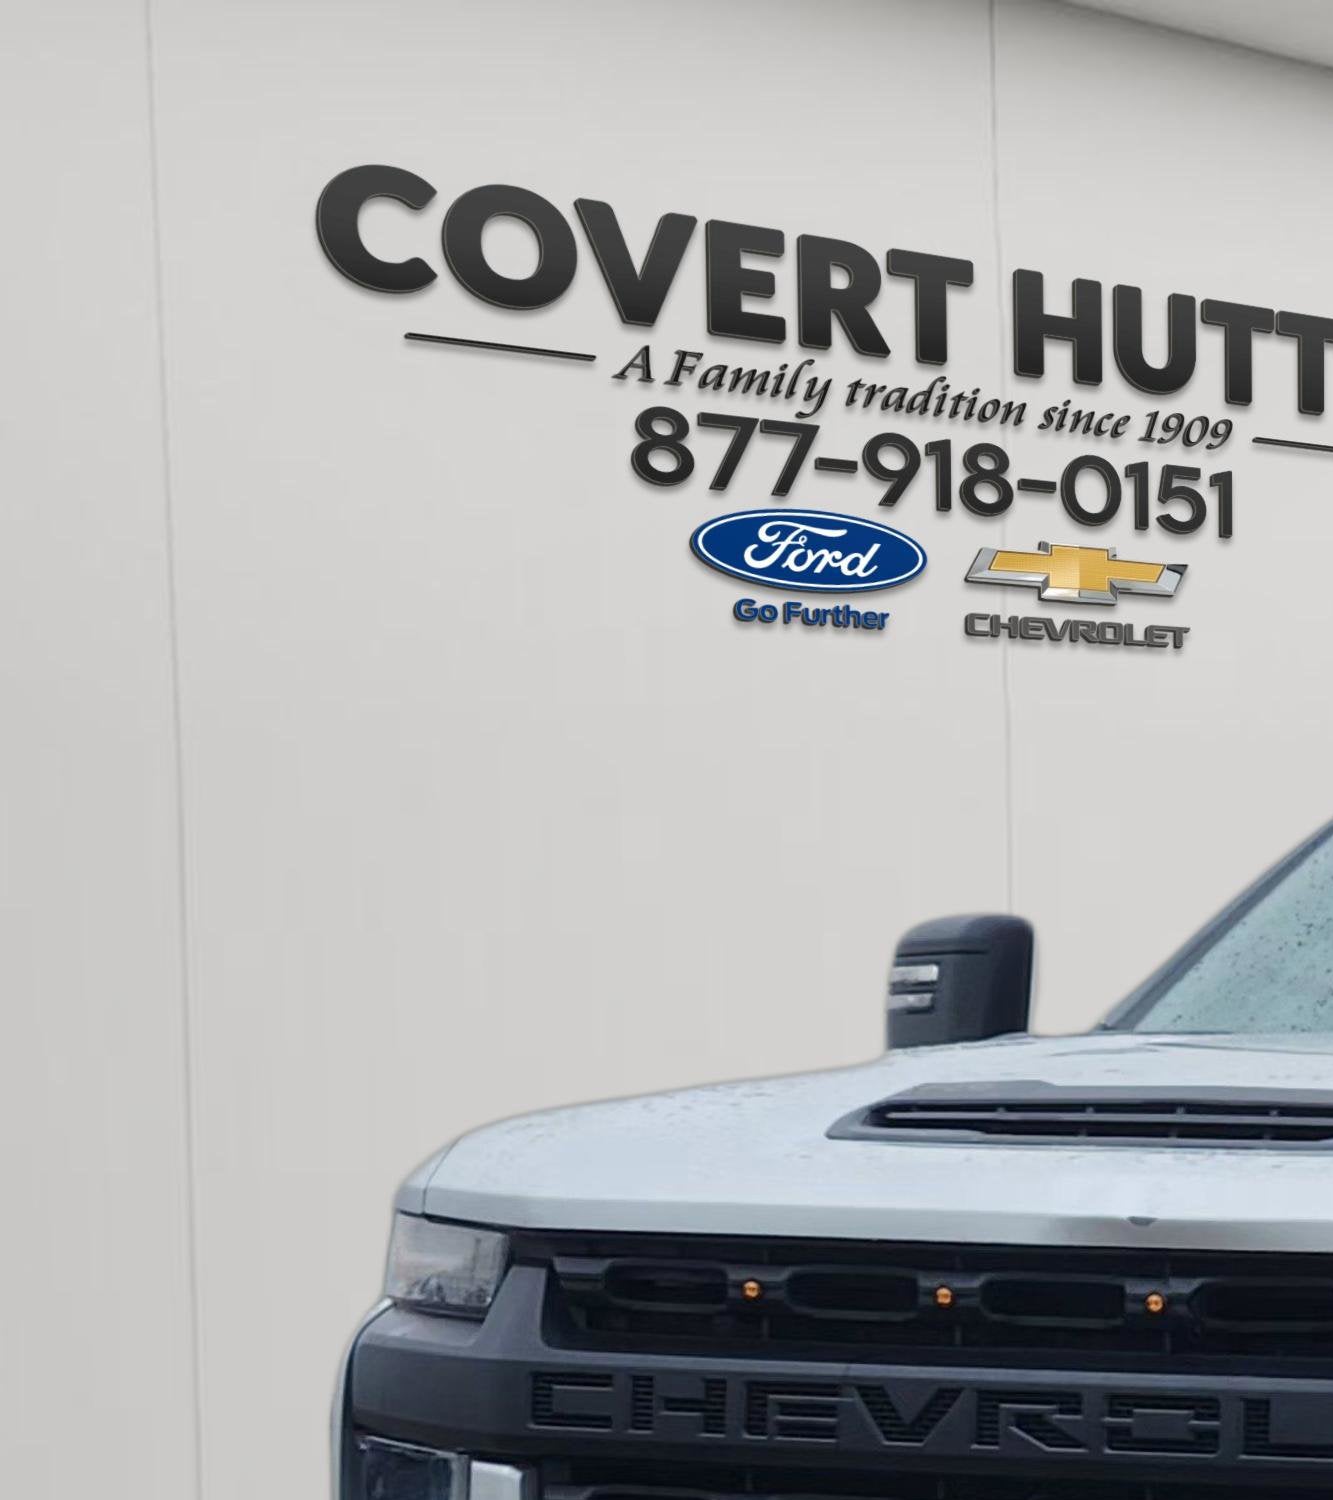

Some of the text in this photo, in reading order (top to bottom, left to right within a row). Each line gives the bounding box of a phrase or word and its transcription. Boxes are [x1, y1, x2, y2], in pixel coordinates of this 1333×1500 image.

[316, 163, 973, 366] COVERT
[612, 344, 1234, 451] A Family tradition since 1909
[630, 405, 1234, 539] 877-918-0151
[742, 520, 882, 578] Ford
[733, 597, 890, 631] Go Further
[964, 611, 1191, 650] CHEVROLET
